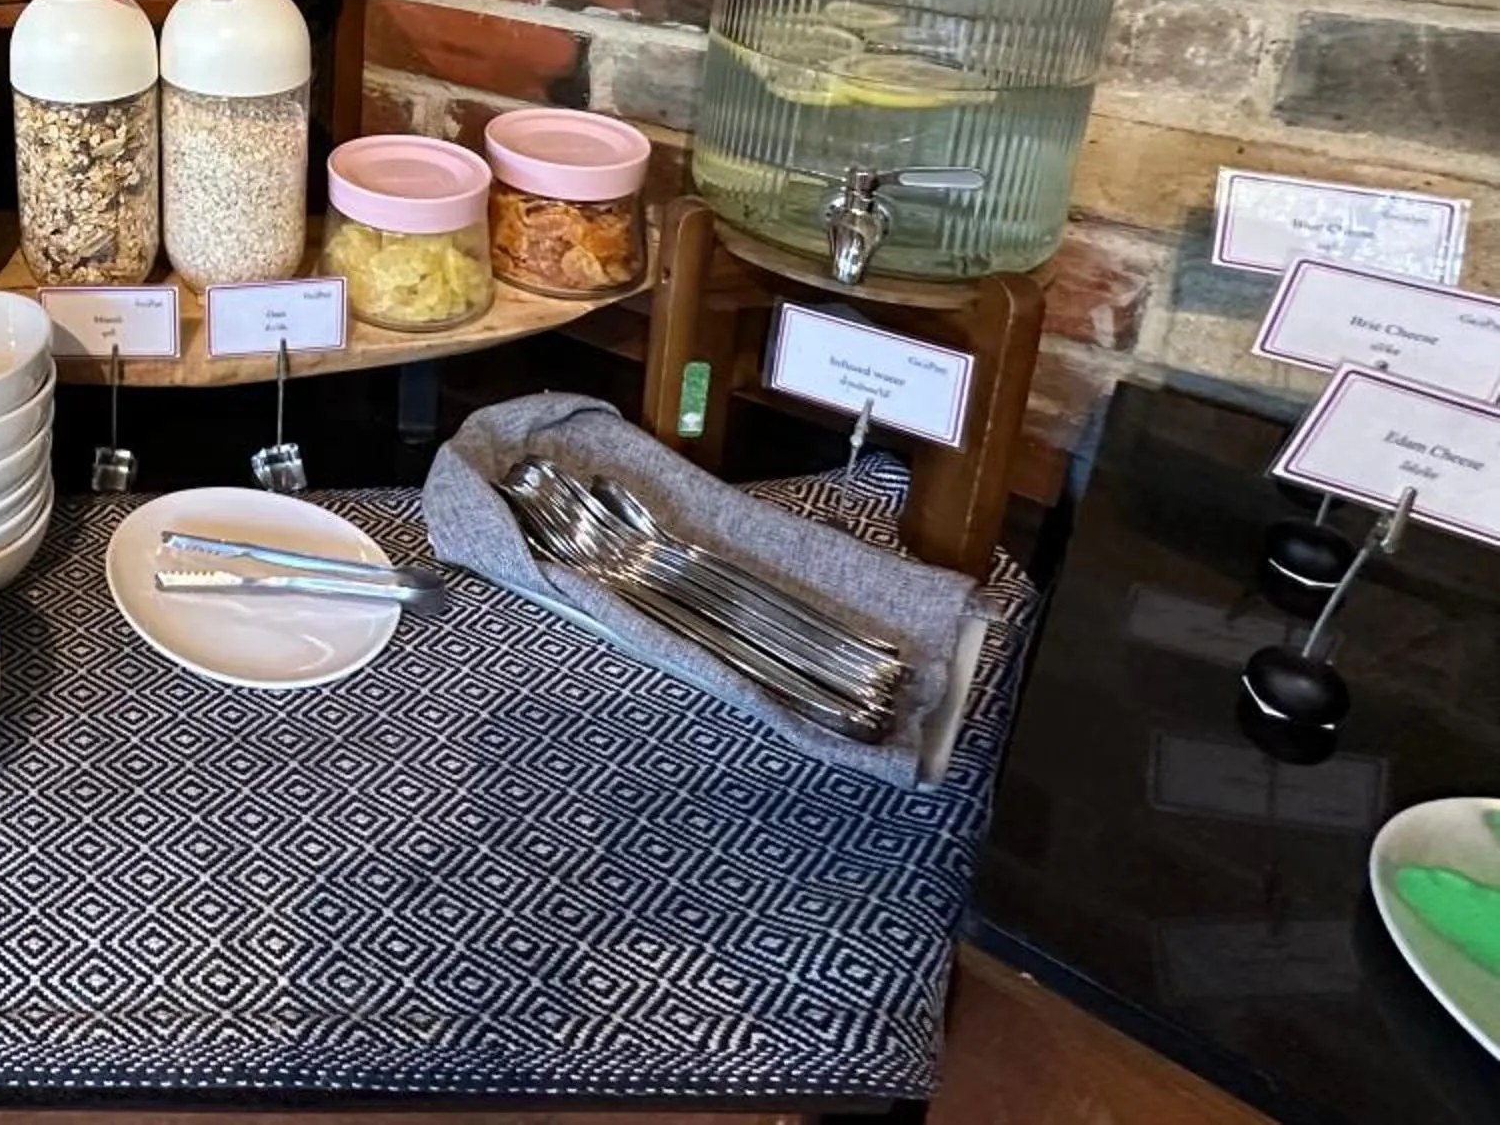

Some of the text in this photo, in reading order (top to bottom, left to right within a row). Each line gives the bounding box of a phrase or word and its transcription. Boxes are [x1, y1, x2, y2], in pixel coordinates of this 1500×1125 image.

[1385, 324, 1440, 346] Cheese
[829, 355, 906, 386] Infused water
[1383, 430, 1427, 454] Edam
[1430, 444, 1485, 471] Cheese
